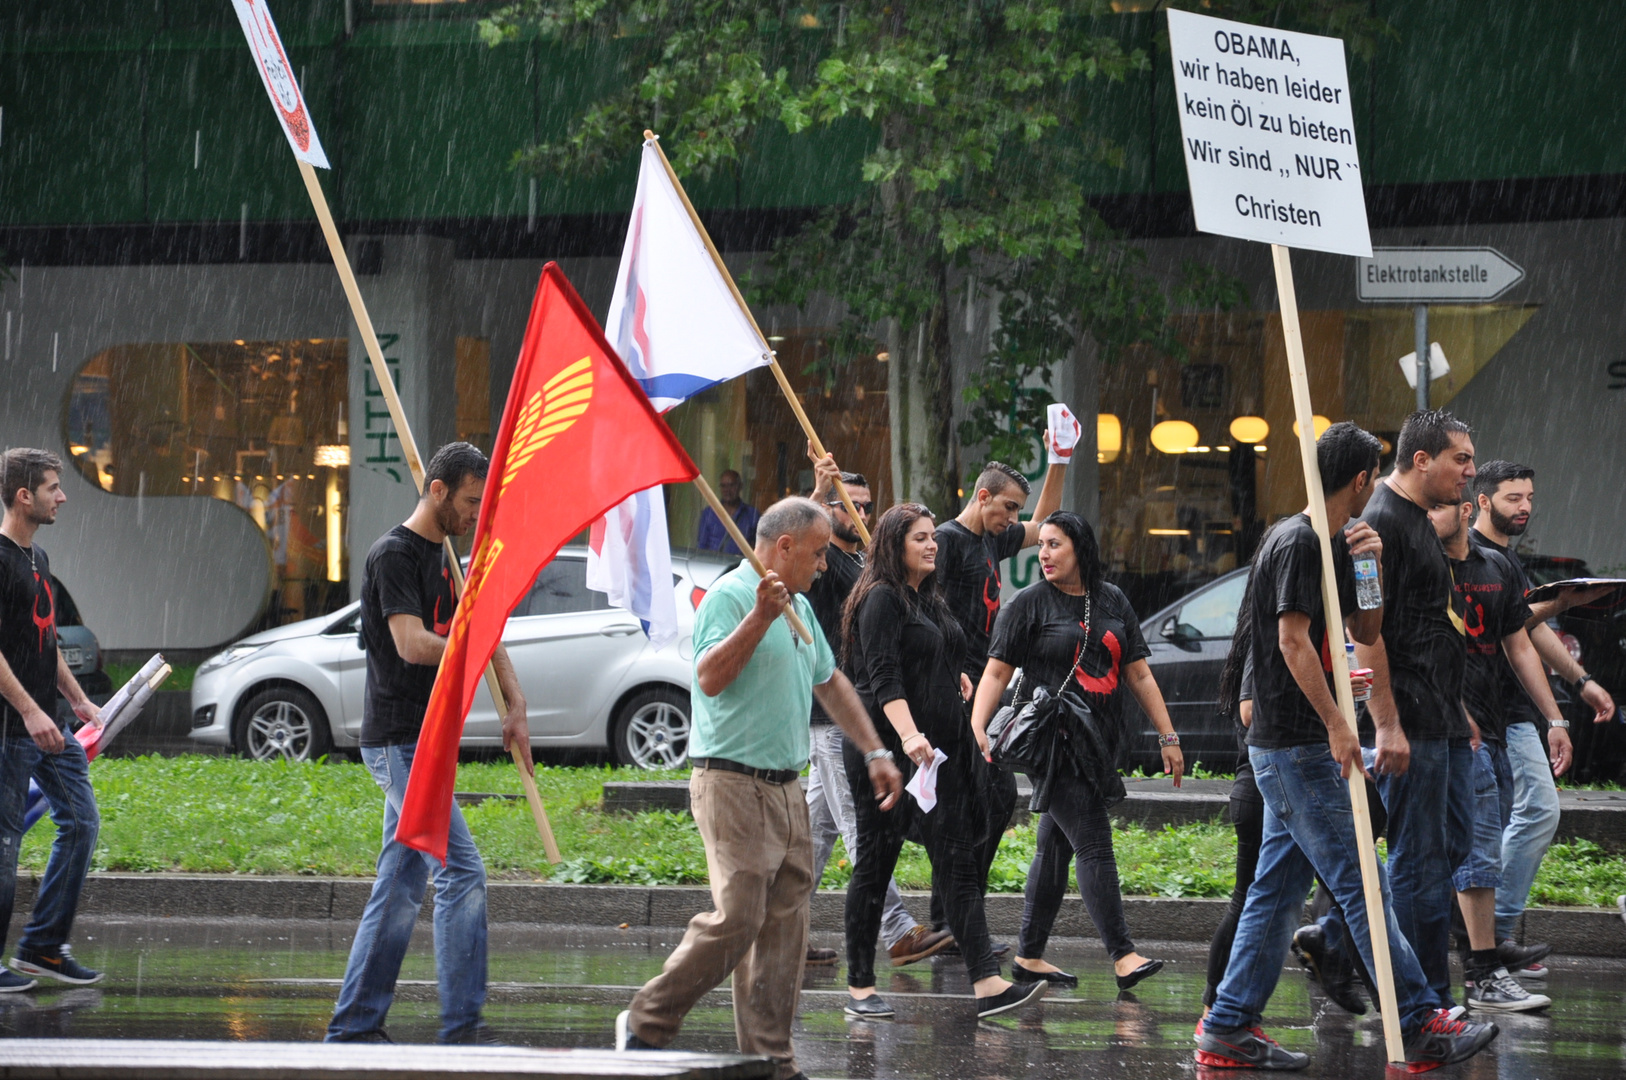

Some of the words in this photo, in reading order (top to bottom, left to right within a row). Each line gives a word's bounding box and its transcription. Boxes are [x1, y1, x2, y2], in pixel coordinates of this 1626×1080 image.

[1214, 30, 1300, 67] OBAMA,
[1179, 57, 1210, 82] wir
[1215, 62, 1279, 95] haben
[1284, 75, 1342, 104] leider
[1184, 92, 1226, 121] kein
[1230, 98, 1253, 128] Öl
[1258, 113, 1283, 133] zu
[1288, 113, 1352, 145] bieten
[1187, 137, 1222, 164] Wir
[1228, 146, 1272, 171] sind
[1235, 193, 1321, 227] Christen
[1367, 264, 1488, 283] Elektrotankstelle
